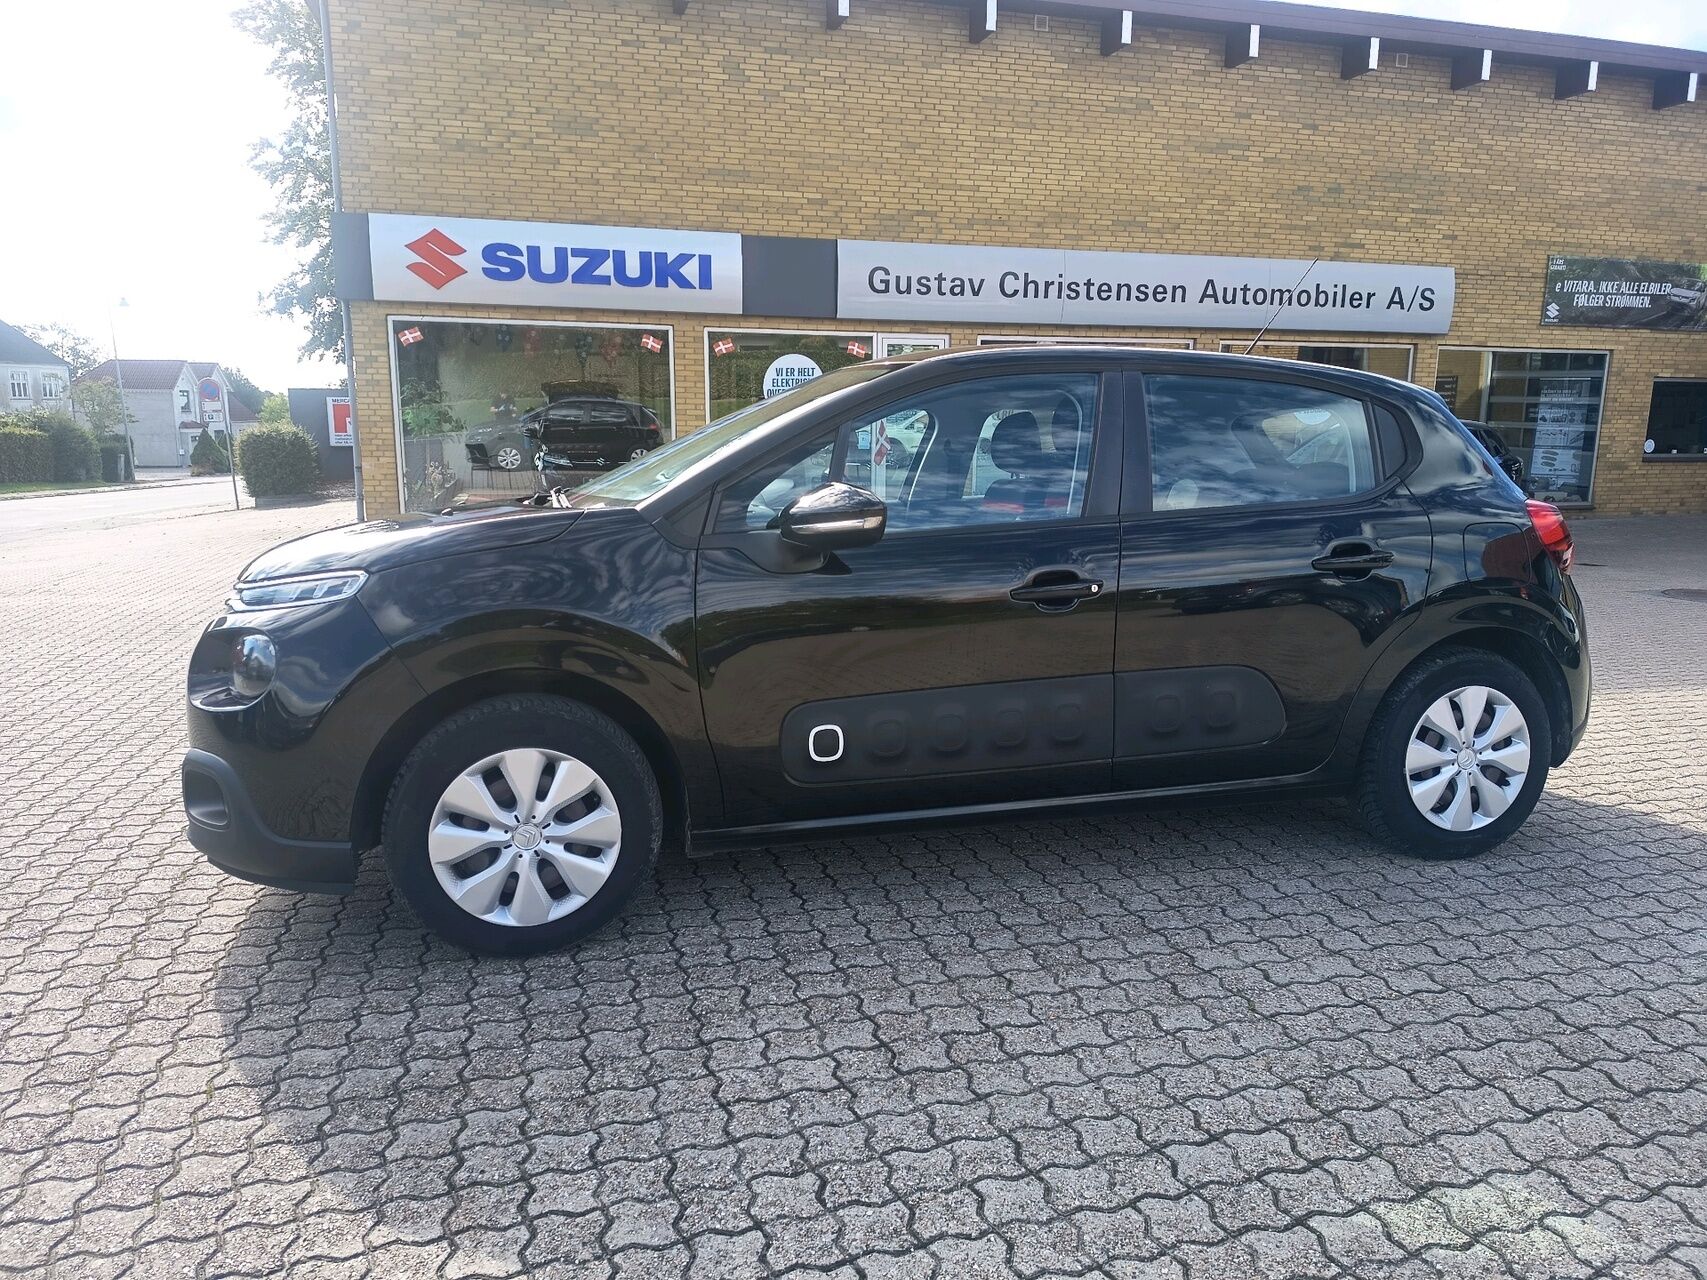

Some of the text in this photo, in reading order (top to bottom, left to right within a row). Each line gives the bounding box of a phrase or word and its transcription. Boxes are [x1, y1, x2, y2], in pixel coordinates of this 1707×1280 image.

[481, 242, 713, 290] SUZUKI
[867, 266, 1436, 312] Gustav Christensen Automobiler A/S
[1563, 280, 1597, 293] VITARA.
[1599, 281, 1619, 294] IKKE
[1620, 281, 1639, 294] ALLE
[1639, 282, 1672, 295] ELBILER
[1573, 293, 1652, 308] FØLGER STRØMMEN.
[775, 368, 816, 376] VI ER HELT
